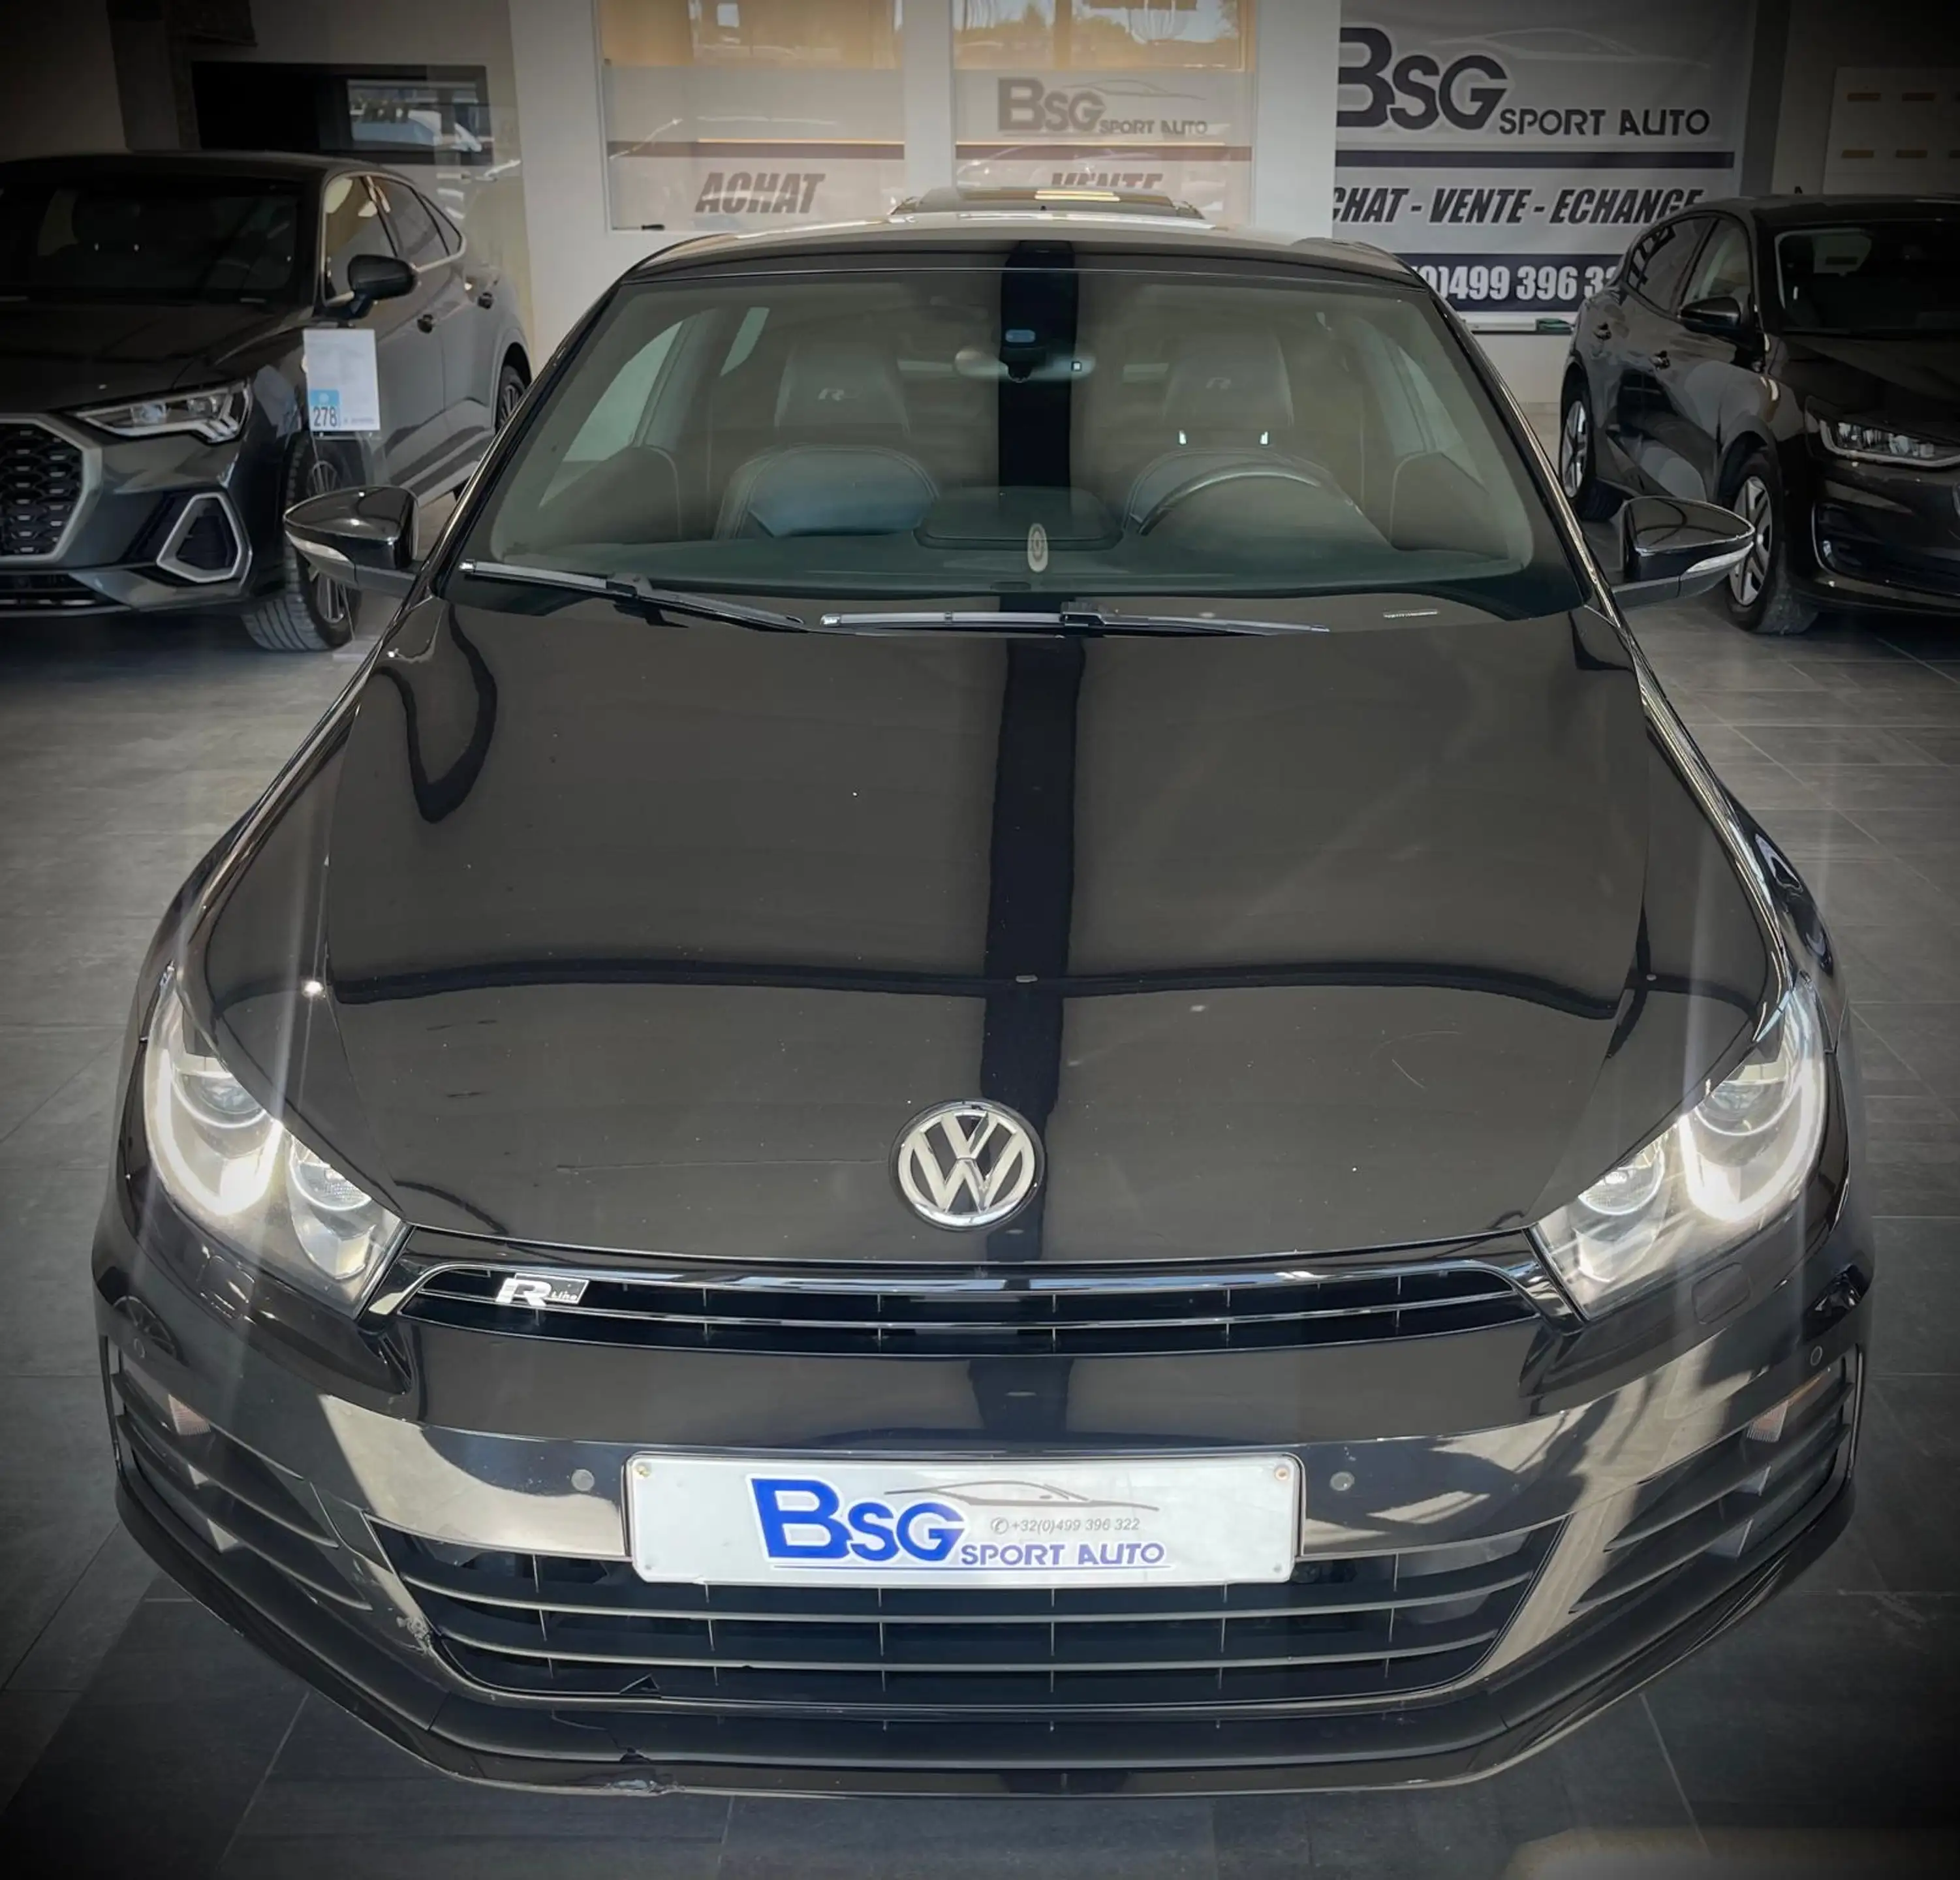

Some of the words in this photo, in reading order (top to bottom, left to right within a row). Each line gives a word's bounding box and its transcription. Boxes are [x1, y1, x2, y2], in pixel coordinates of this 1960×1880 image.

[997, 77, 1105, 132] BSG
[1099, 120, 1155, 135] SPORT
[1160, 121, 1207, 135] AUTO
[1499, 108, 1606, 135] SPORT
[1619, 109, 1711, 136] AUTO
[694, 172, 826, 213] ACHAT
[1429, 189, 1532, 223] VENTE
[1516, 265, 1579, 301] 396
[313, 406, 337, 428] 278
[899, 1104, 1035, 1223] VW
[495, 1277, 552, 1308] R
[751, 1478, 965, 1562] BSG
[961, 1543, 1066, 1565] SPORT
[1078, 1542, 1165, 1565] AUTO
[1012, 1518, 1081, 1535] +32(0)499
[1085, 1518, 1112, 1532] 396
[1114, 1518, 1141, 1531] 322
